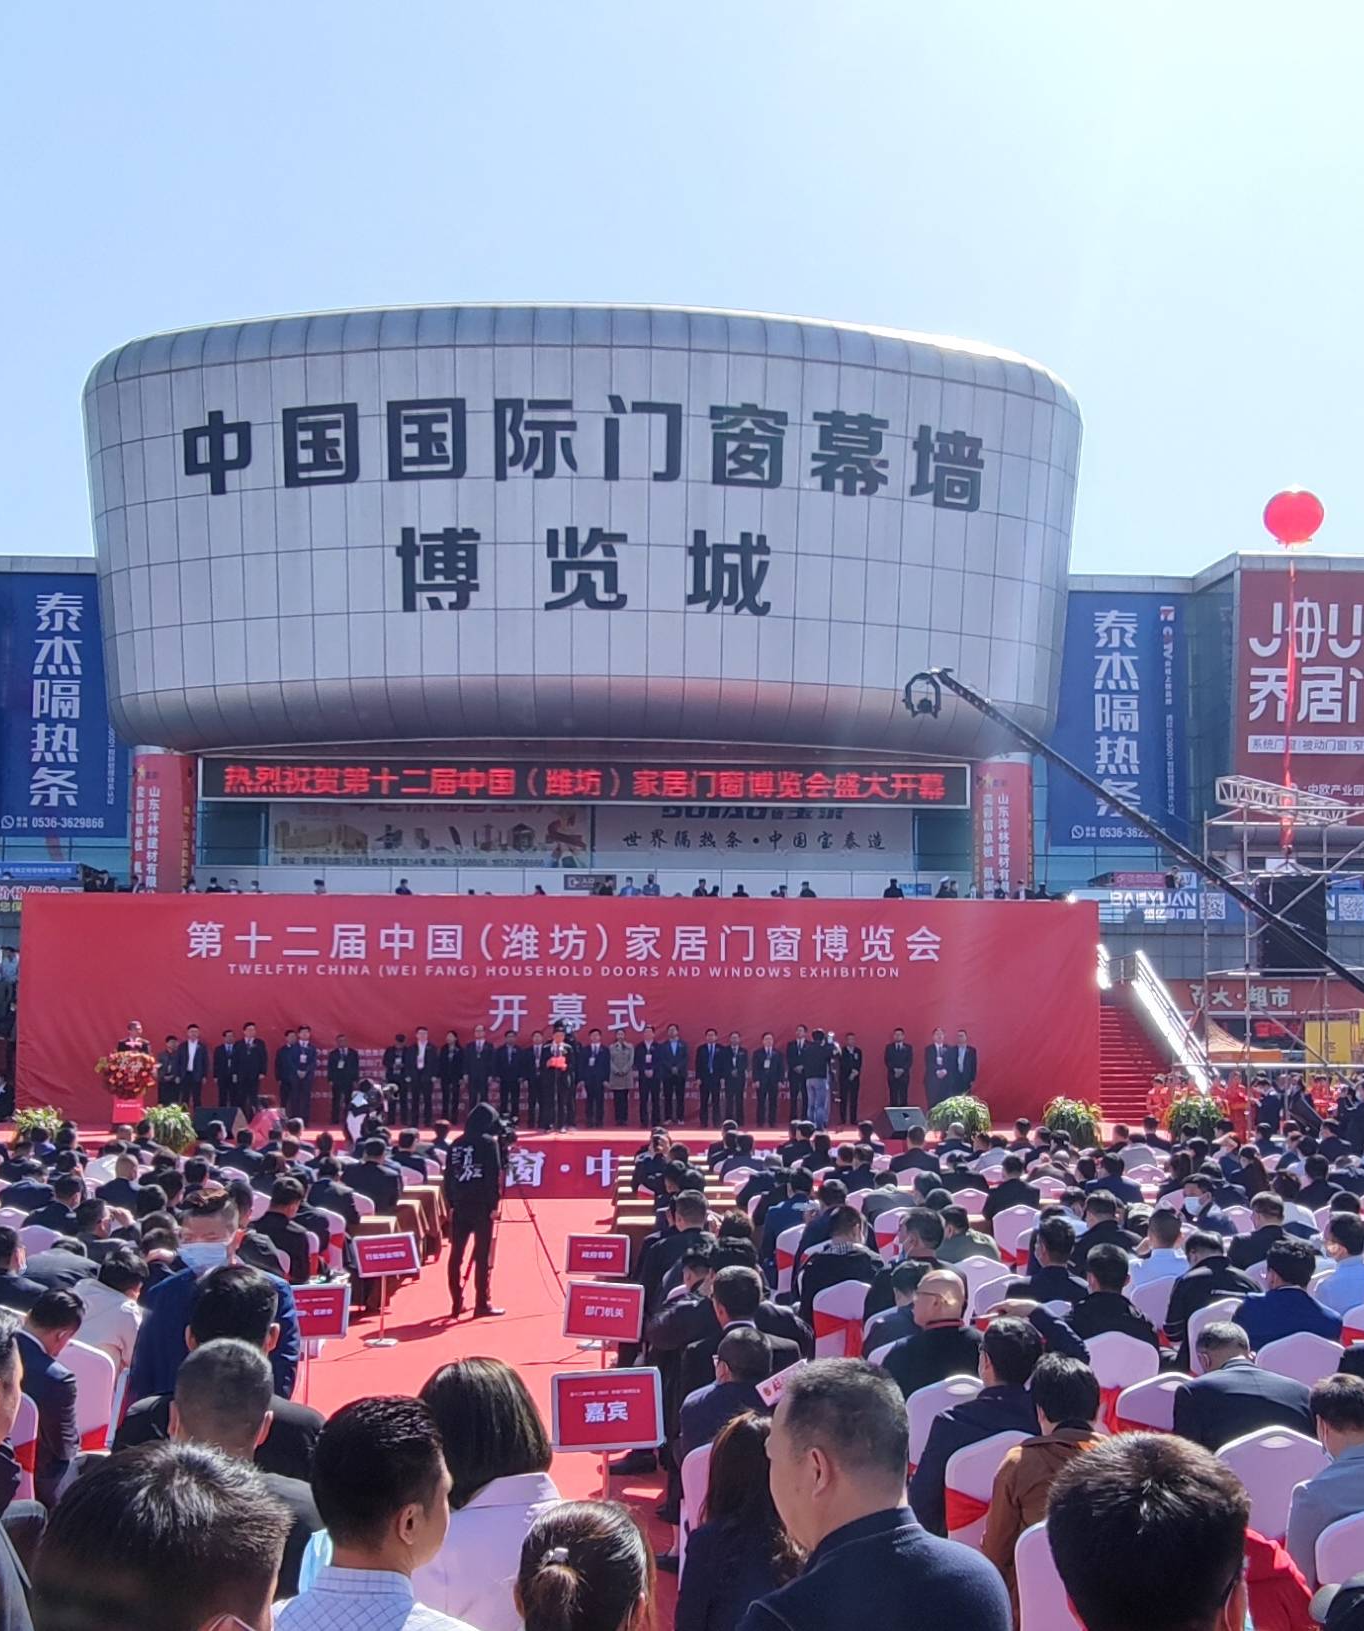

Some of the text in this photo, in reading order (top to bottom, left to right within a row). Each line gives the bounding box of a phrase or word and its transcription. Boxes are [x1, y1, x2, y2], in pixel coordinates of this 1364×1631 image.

[183, 394, 985, 513] 中国国际门窗幕墙
[395, 526, 771, 616] 博览城
[30, 592, 83, 807] 泰杰隔热条
[1094, 610, 1140, 817] 泰杰隔热条
[1302, 738, 1347, 751] 被动门窗
[224, 766, 945, 801] 热烈祝贺第十二届中国（潍坊）家居门窗博览会盛大开幕
[187, 921, 941, 962] 第十二届中国（潍坊）家居门窗博览会
[228, 963, 900, 980] TWELFTH CHINA (WEI FANG) HOUSEHOLD DOORS AND WINDOWS EXHIBITION
[488, 992, 646, 1032] 开幕式
[585, 1305, 624, 1318] 部门机关
[584, 1401, 628, 1423] 嘉宾
